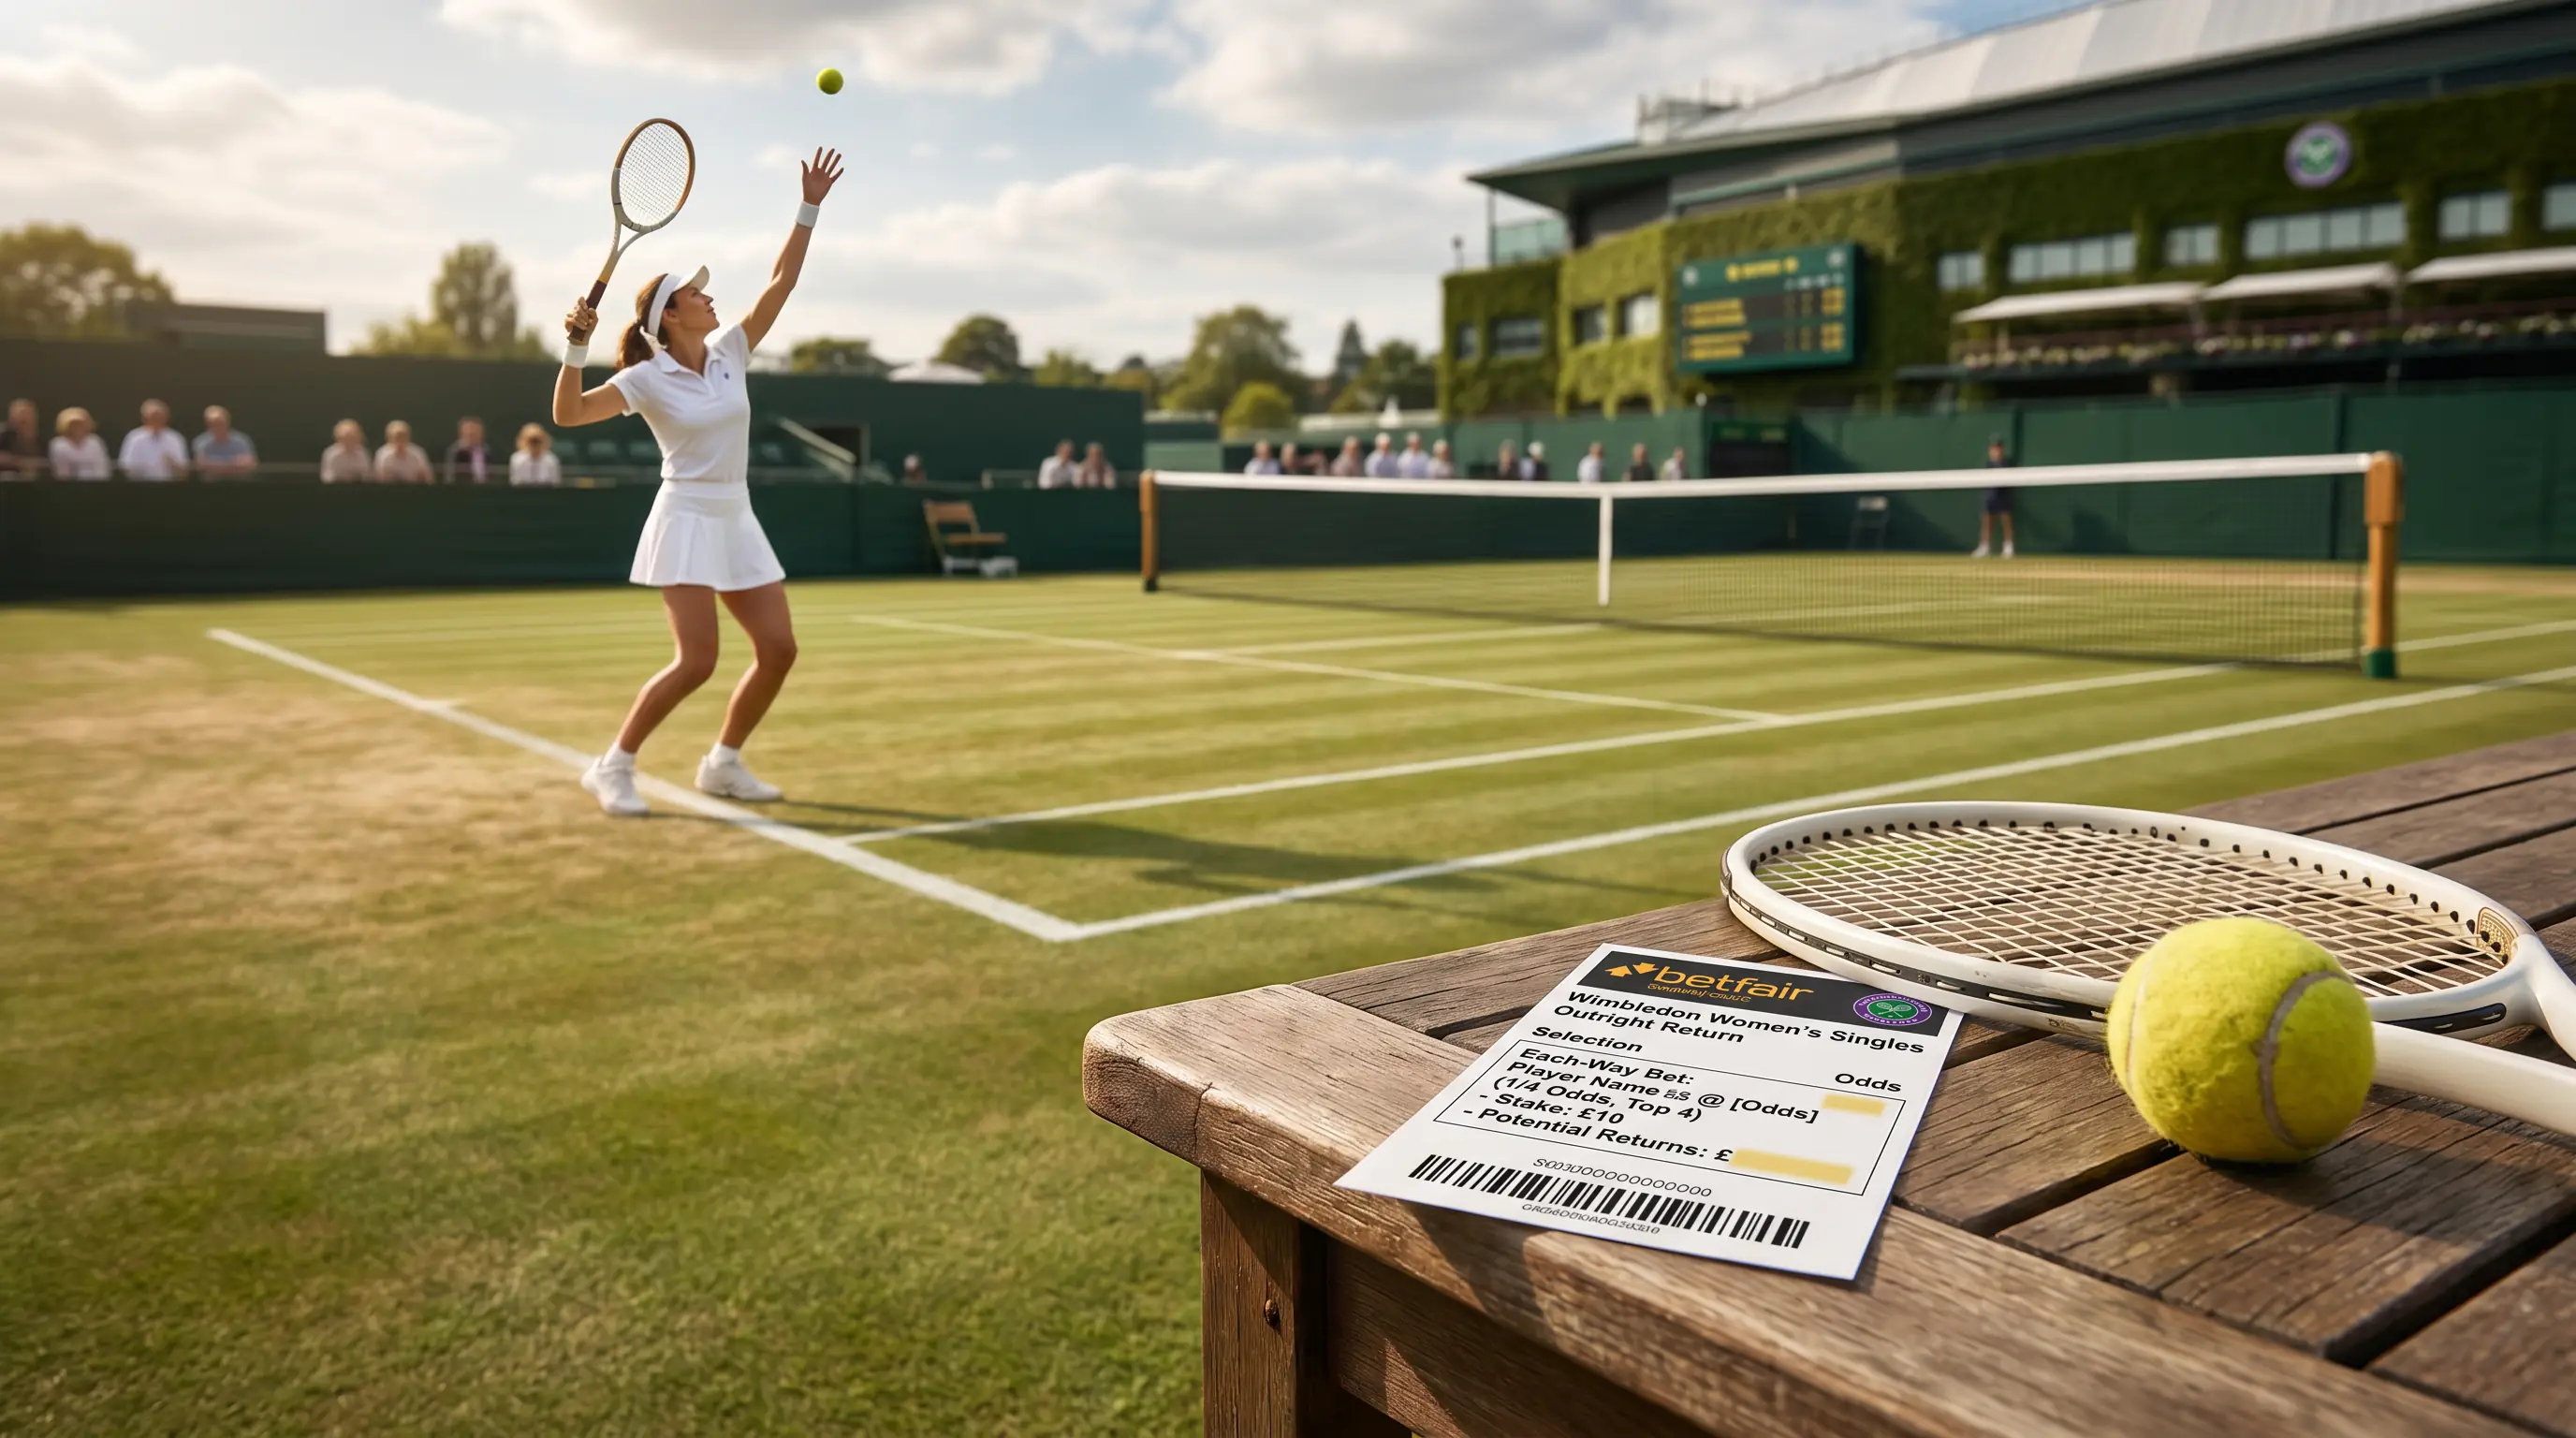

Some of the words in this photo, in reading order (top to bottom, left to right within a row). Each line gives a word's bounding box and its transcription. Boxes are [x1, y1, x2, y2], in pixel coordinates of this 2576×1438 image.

[1653, 965, 1815, 1002] betfair
[1531, 1026, 1643, 1052] Selection
[1554, 1005, 1656, 1030] Outright
[1660, 1020, 1744, 1043] Return
[1568, 990, 1702, 1021] Wimbledon
[1709, 1012, 1822, 1038] Women’s
[1829, 1030, 1925, 1053] Singles
[1519, 1048, 1640, 1078] Each-Way
[1644, 1067, 1694, 1085] Bet:
[1835, 1073, 1902, 1093] Odds
[1493, 1076, 1542, 1093] (1/4
[1545, 1085, 1616, 1108] Odds,
[1628, 1097, 1671, 1117] Top
[1676, 1108, 1702, 1123] 4)
[1494, 1093, 1573, 1116] Stake:
[1576, 1108, 1625, 1124] £10
[1506, 1061, 1587, 1083] Player
[1588, 1076, 1661, 1096] Name
[1697, 1093, 1725, 1108] @
[1729, 1097, 1820, 1124] [Odds]
[1477, 1108, 1593, 1137] Potential
[1595, 1128, 1708, 1158] Returns:
[1713, 1149, 1734, 1162] £
